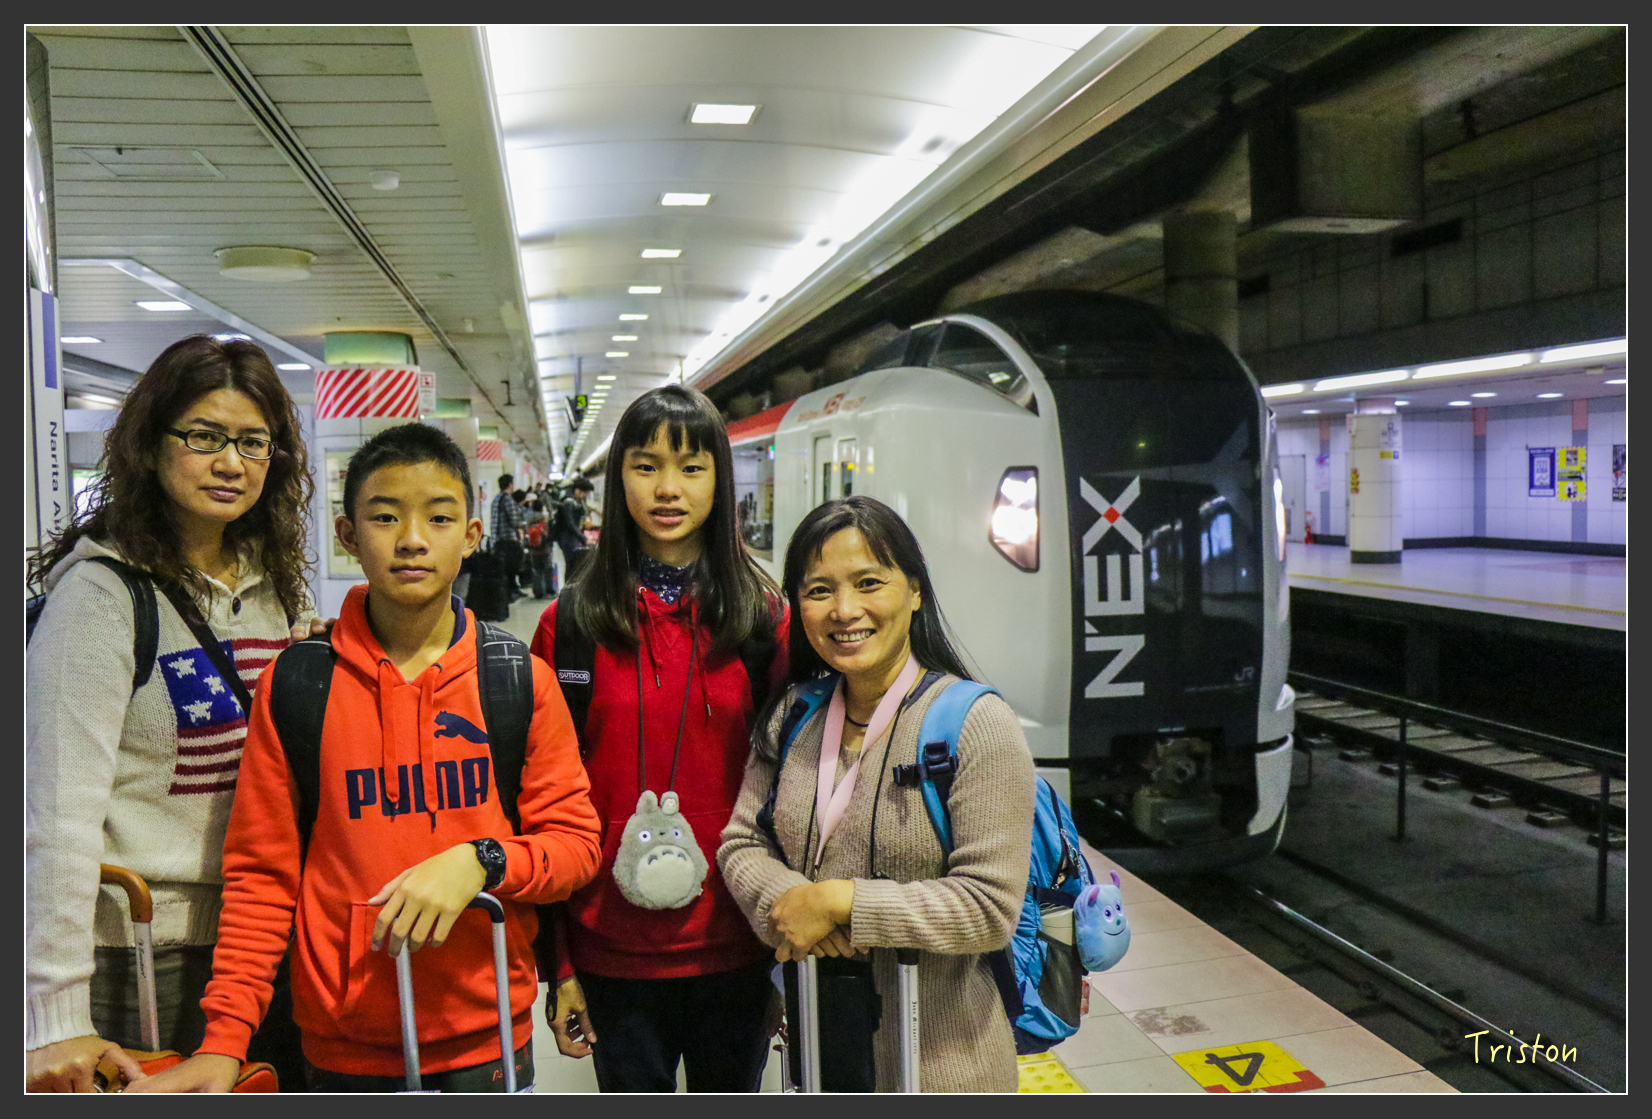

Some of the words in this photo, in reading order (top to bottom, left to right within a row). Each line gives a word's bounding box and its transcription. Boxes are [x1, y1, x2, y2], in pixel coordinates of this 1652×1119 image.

[577, 395, 587, 407] 3
[49, 421, 60, 492] Narita
[345, 756, 489, 820] PUMA
[1204, 1052, 1265, 1087] 4
